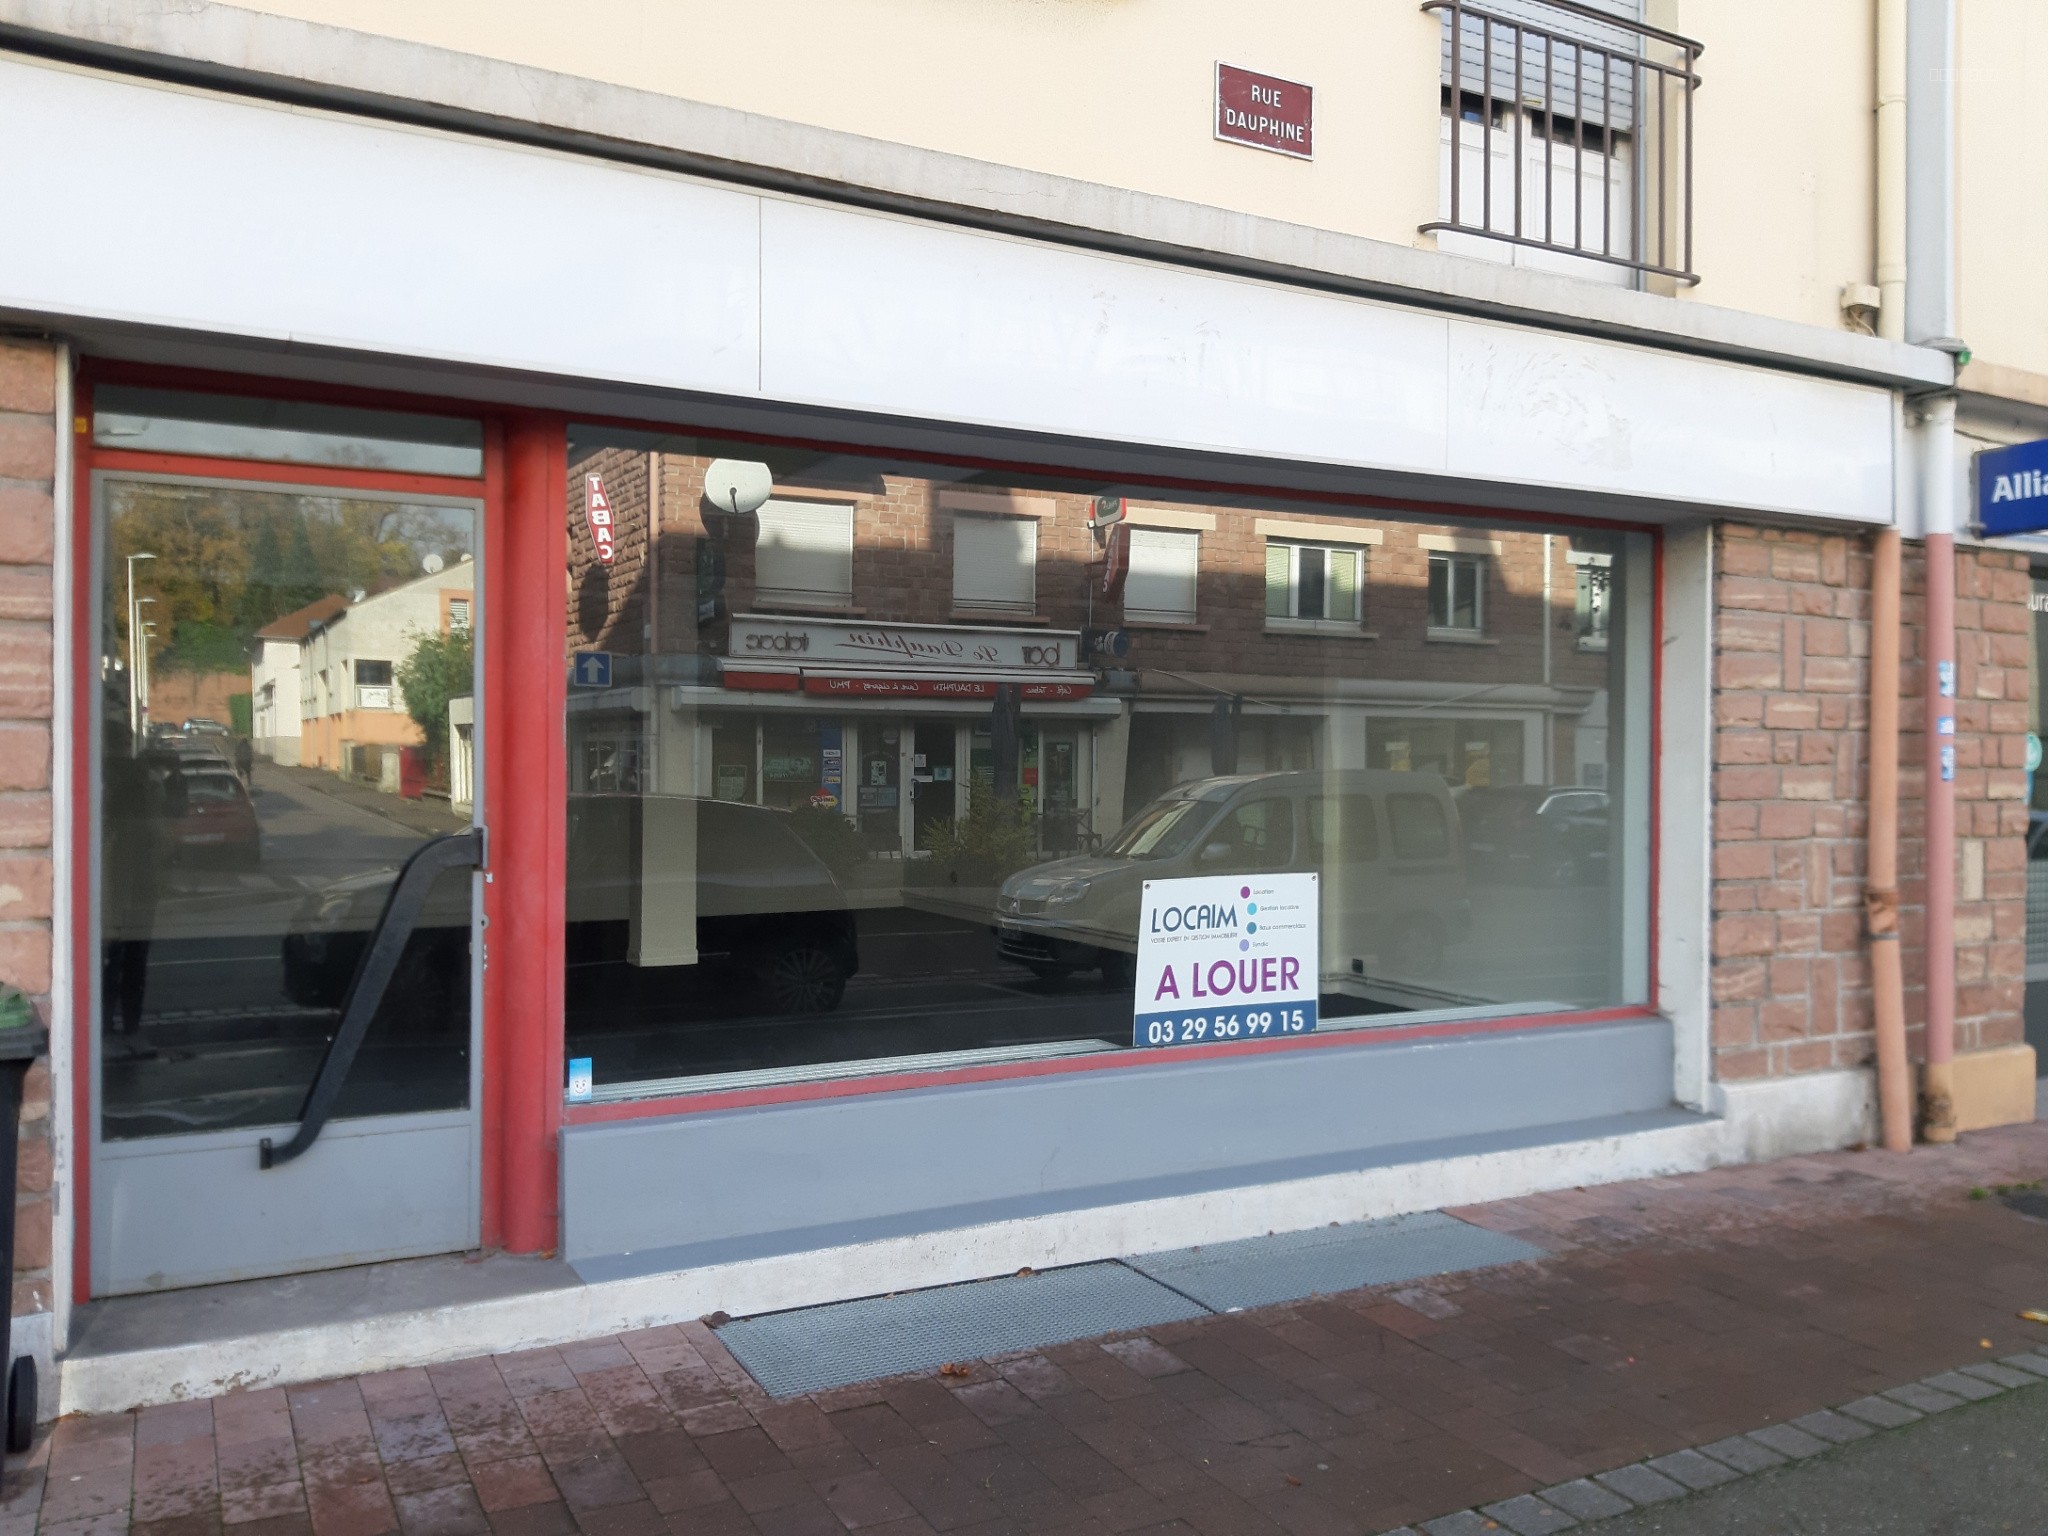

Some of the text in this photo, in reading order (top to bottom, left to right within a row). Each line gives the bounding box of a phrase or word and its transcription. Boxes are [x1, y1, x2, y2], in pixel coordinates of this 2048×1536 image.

[1251, 84, 1282, 108] RUE
[1225, 108, 1305, 143] DAUPHINE
[1151, 902, 1238, 933] LOCAIM
[1154, 956, 1300, 1001] A LOUER
[1148, 1009, 1304, 1044] 03 29 56 99 15
